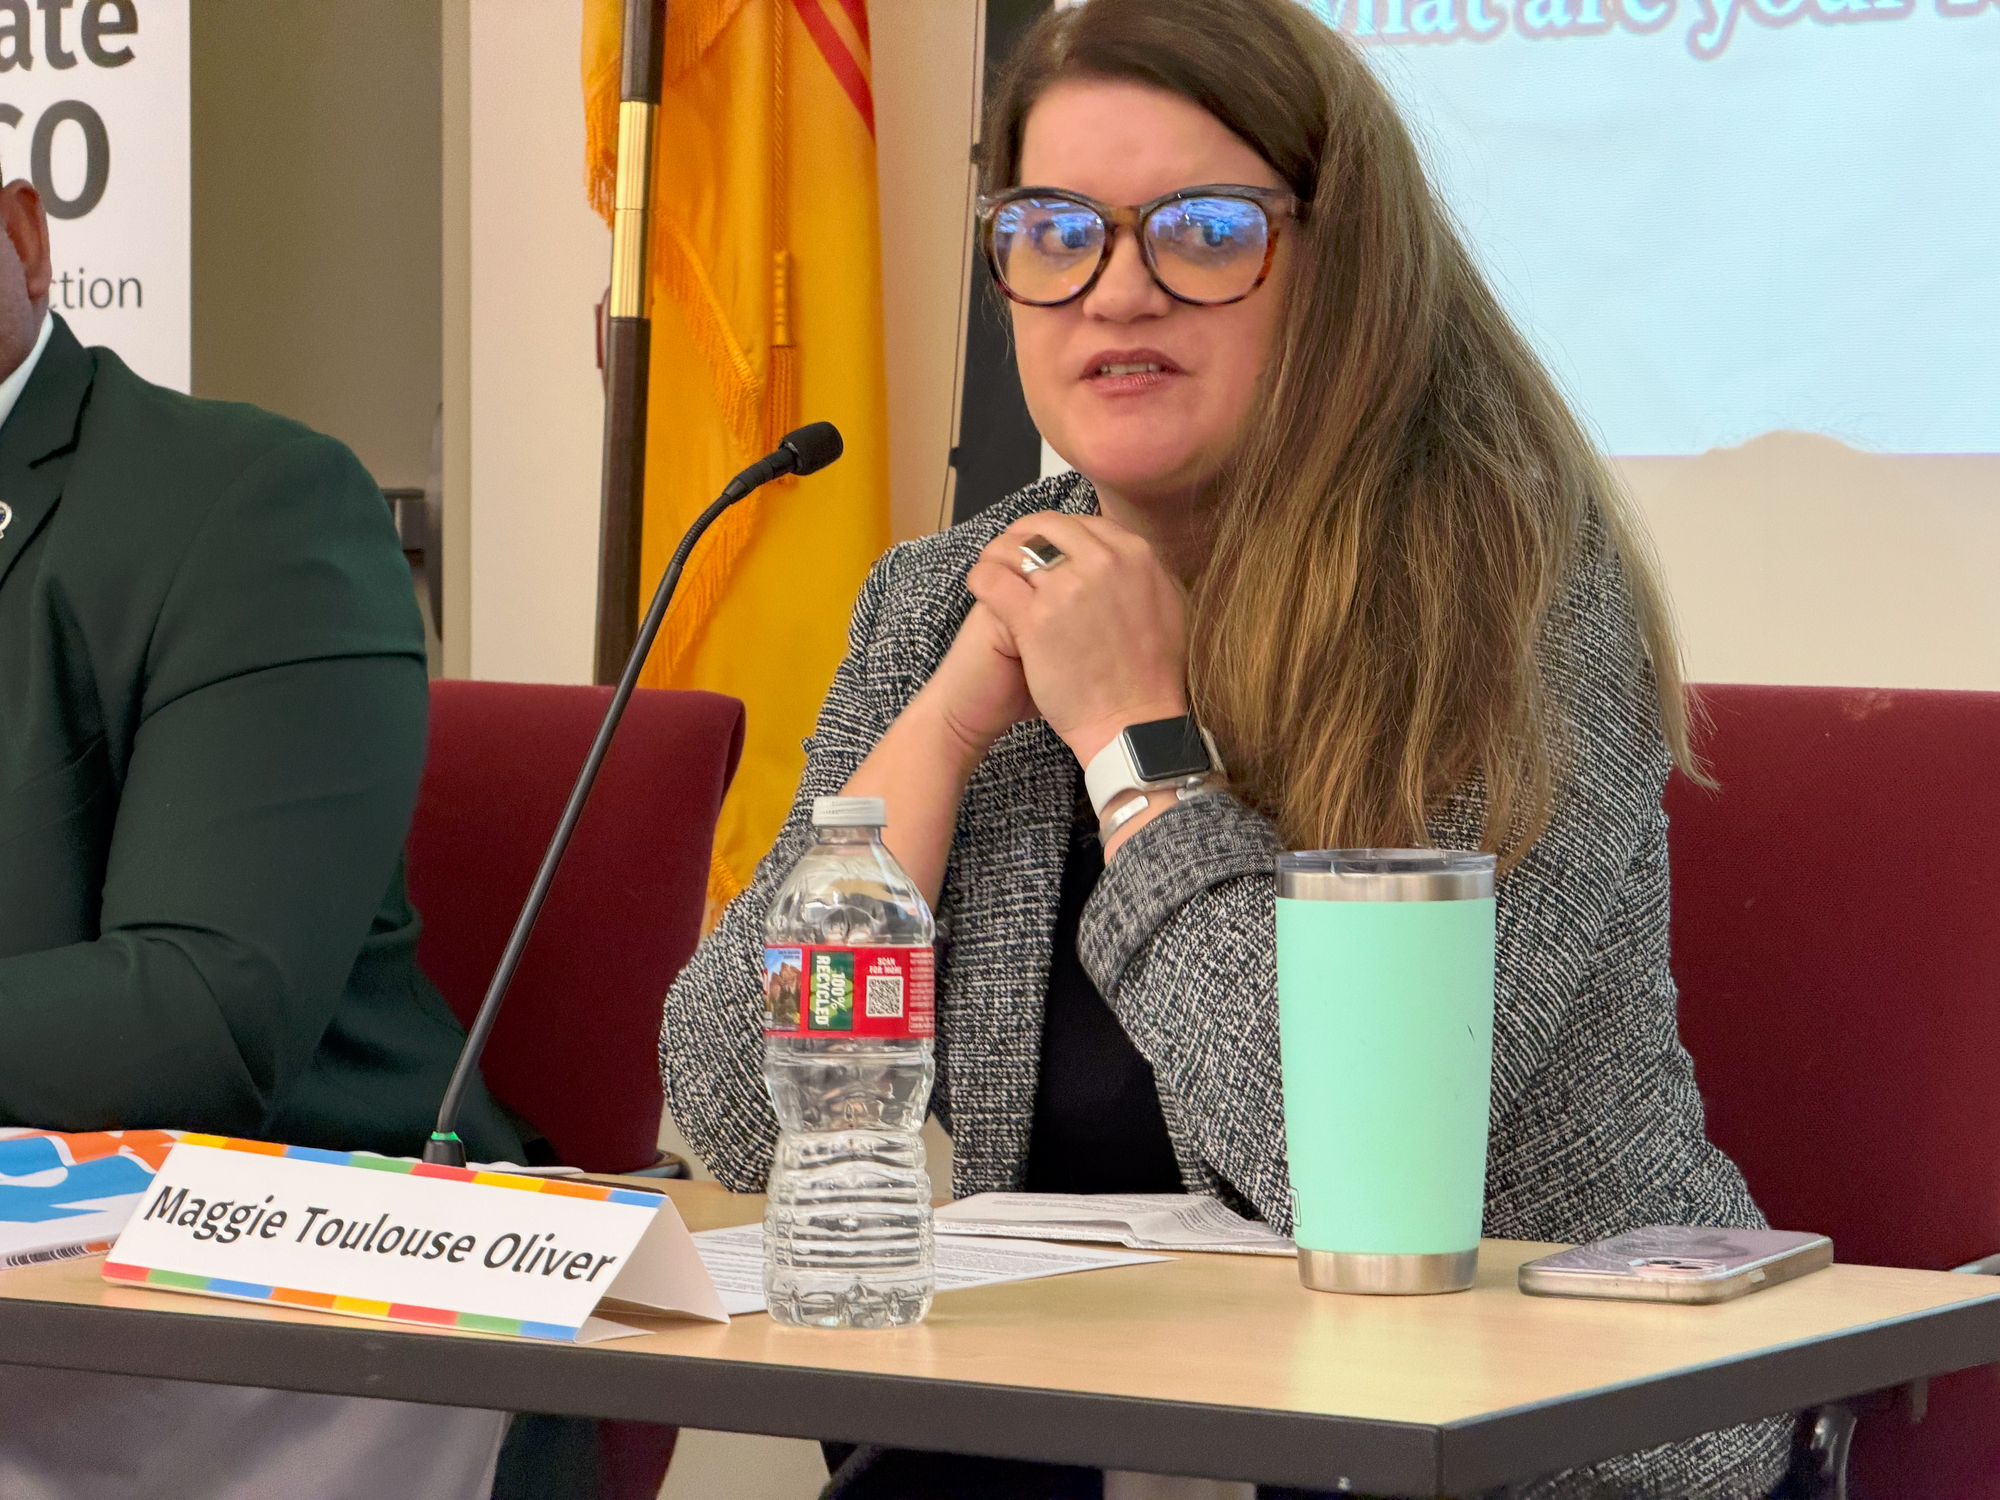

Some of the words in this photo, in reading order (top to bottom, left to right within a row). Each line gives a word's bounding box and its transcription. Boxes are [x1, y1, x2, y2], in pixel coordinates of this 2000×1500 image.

[51, 266, 143, 310] tion
[815, 955, 831, 1026] RECYCLED
[830, 972, 846, 1010] 100%
[143, 1185, 288, 1244] Maggie
[295, 1206, 477, 1263] Toulouse
[483, 1232, 618, 1283] Oliver
